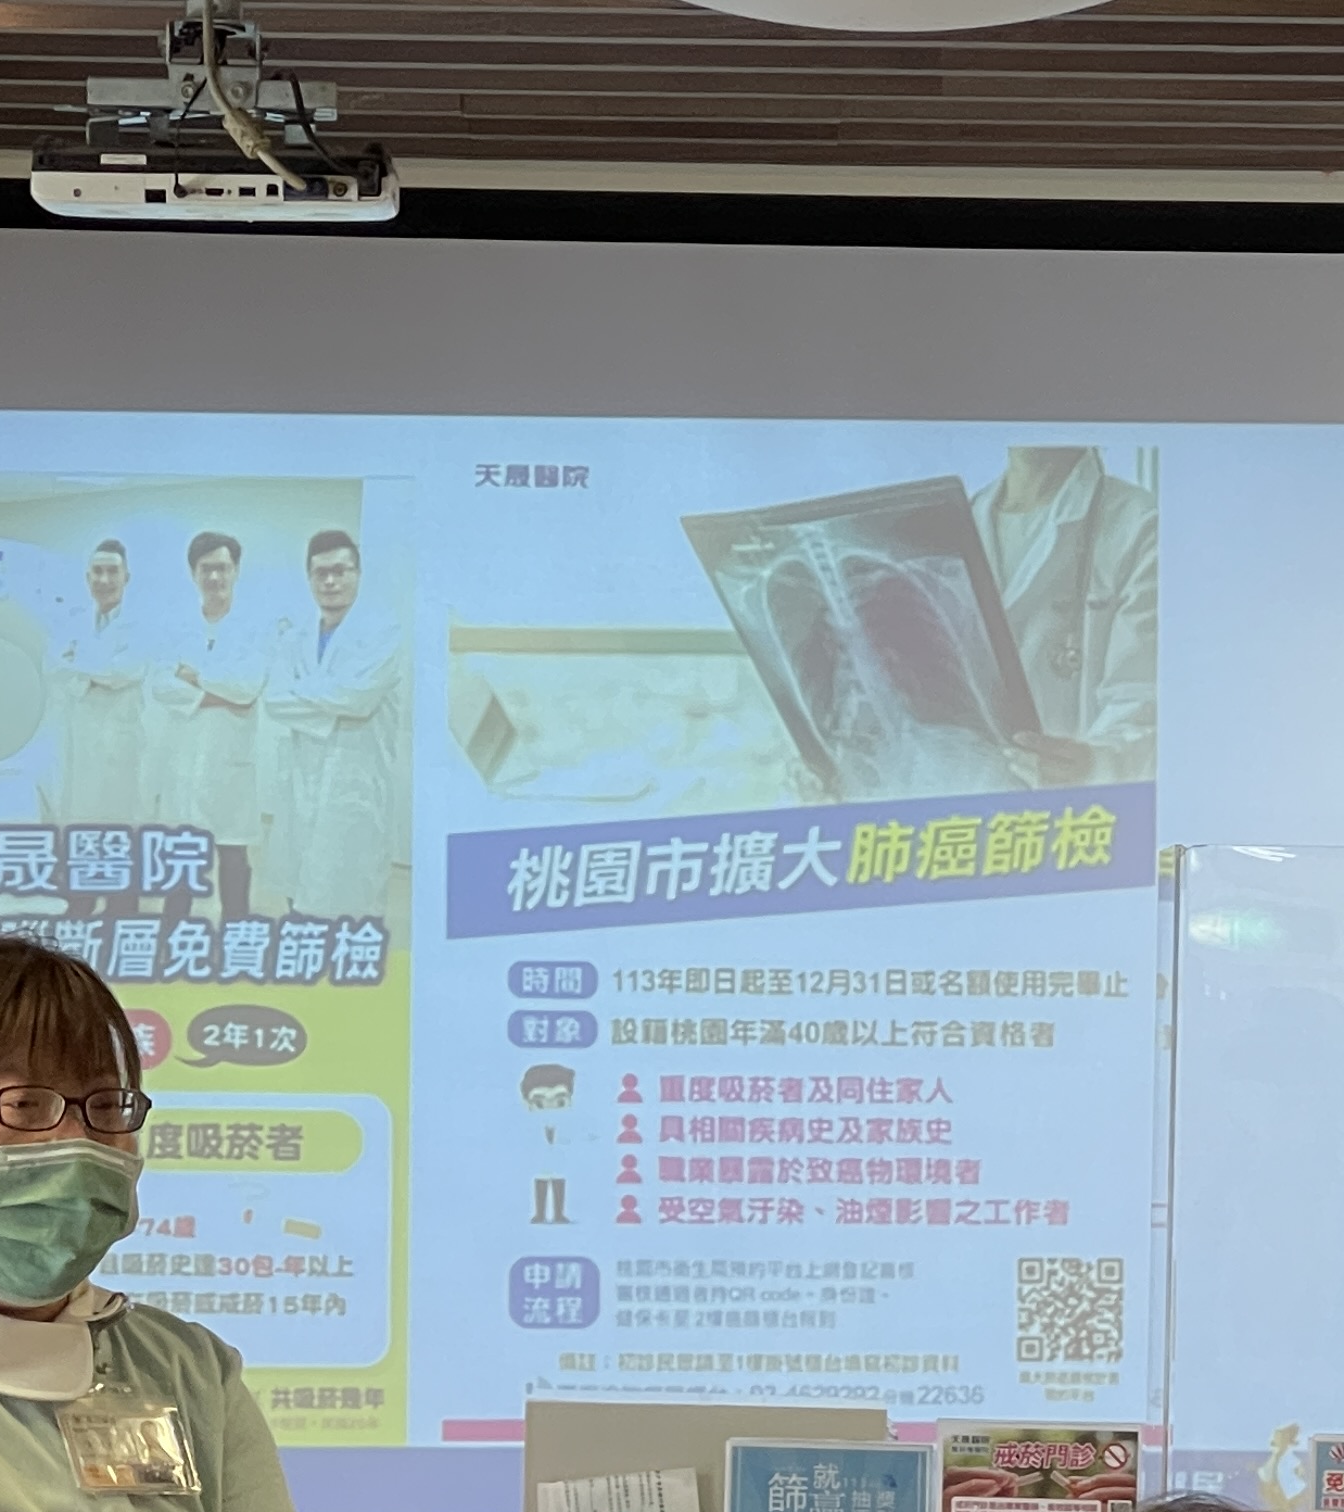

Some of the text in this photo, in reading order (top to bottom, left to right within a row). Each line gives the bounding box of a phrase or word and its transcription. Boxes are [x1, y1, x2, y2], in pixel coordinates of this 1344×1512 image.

[473, 463, 590, 489] 天晟醫院
[507, 805, 1117, 913] 桃園市擴大肺癌篩檢
[521, 964, 584, 995] 時間
[202, 1021, 298, 1053] 2年1次
[521, 1014, 584, 1044] 對象
[993, 1442, 1097, 1471] 戒菸門診
